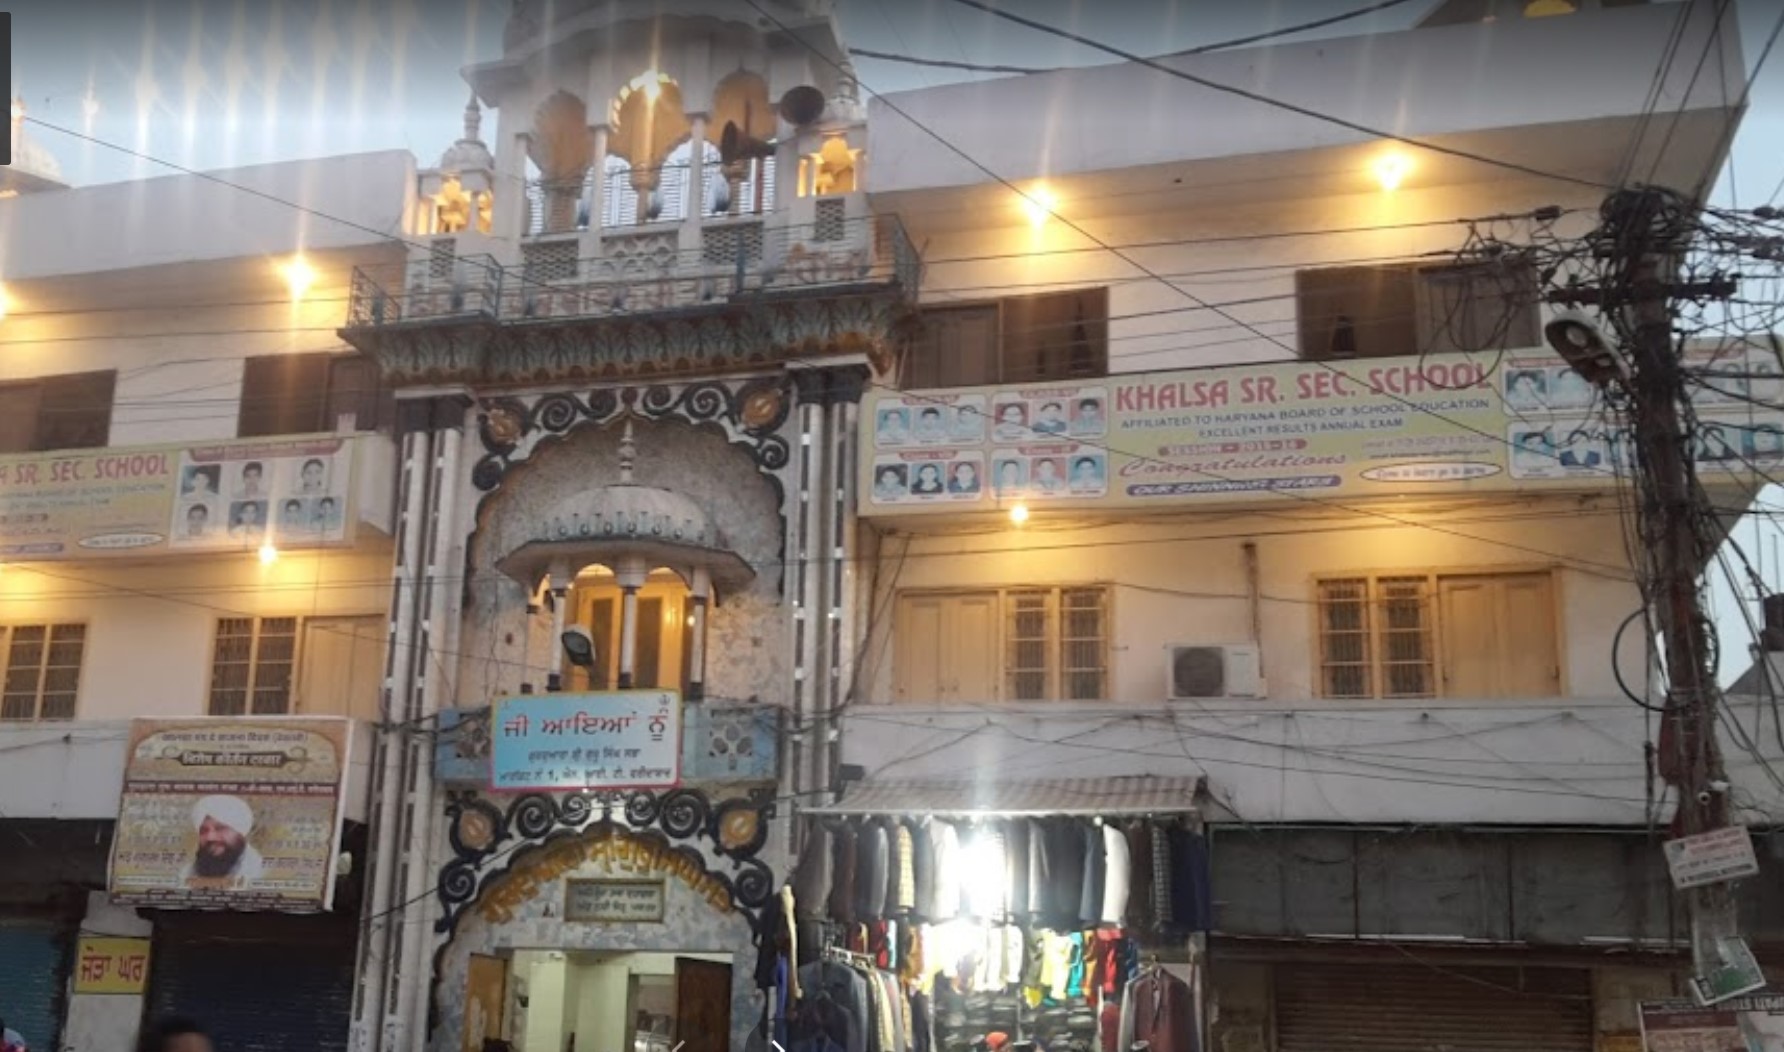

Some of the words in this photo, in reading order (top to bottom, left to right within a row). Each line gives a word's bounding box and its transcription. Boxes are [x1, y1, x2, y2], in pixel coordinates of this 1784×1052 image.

[1116, 379, 1229, 412] KHALSA
[1240, 376, 1286, 404] SR.
[1297, 371, 1356, 399] SEC.
[1368, 362, 1492, 395] SCHOOL
[1121, 414, 1192, 429] AFFILIATED
[1195, 414, 1211, 425] TO
[1215, 411, 1275, 424] HARYANA
[1280, 406, 1325, 420] BOARD
[1329, 406, 1345, 417] OF
[1352, 403, 1405, 416] SCHOOL
[1411, 399, 1490, 412] EDUCATION
[1199, 426, 1263, 438] EXCELLENT
[1267, 421, 1317, 435] RESULTS
[1320, 418, 1365, 431] ANNUAL
[1369, 417, 1403, 429] EXAM
[94, 455, 168, 479] SCHOOL
[1118, 453, 1346, 477] Congratulations
[504, 712, 529, 737] ਜੀ
